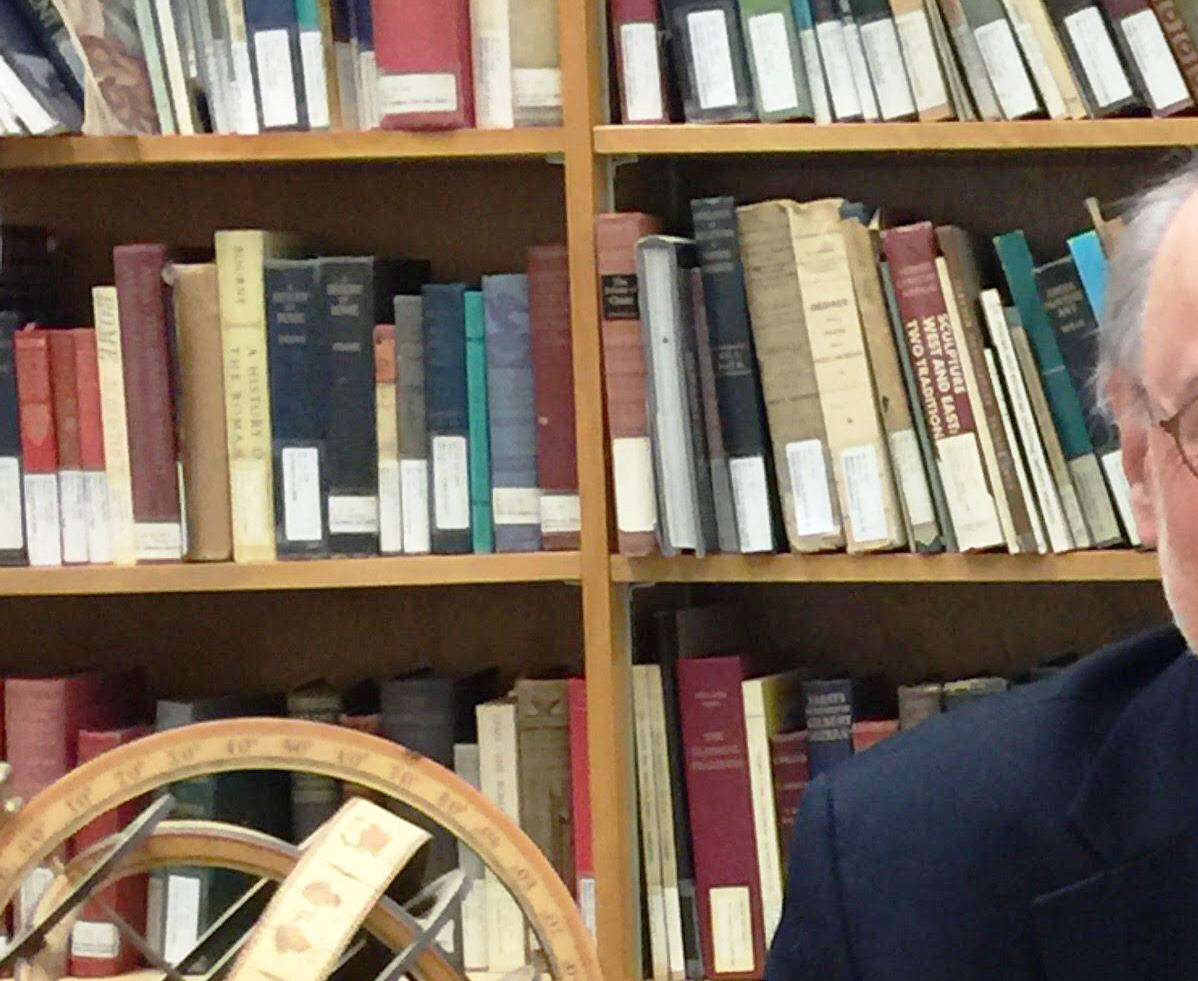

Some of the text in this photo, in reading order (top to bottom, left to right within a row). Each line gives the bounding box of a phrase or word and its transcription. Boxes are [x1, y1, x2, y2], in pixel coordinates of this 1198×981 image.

[906, 319, 924, 357] TWO
[916, 358, 945, 439] TRADITION
[923, 315, 943, 356] WEST
[933, 358, 950, 393] AND
[937, 313, 966, 395] SCULPTURE
[248, 366, 262, 437] HISTORY
